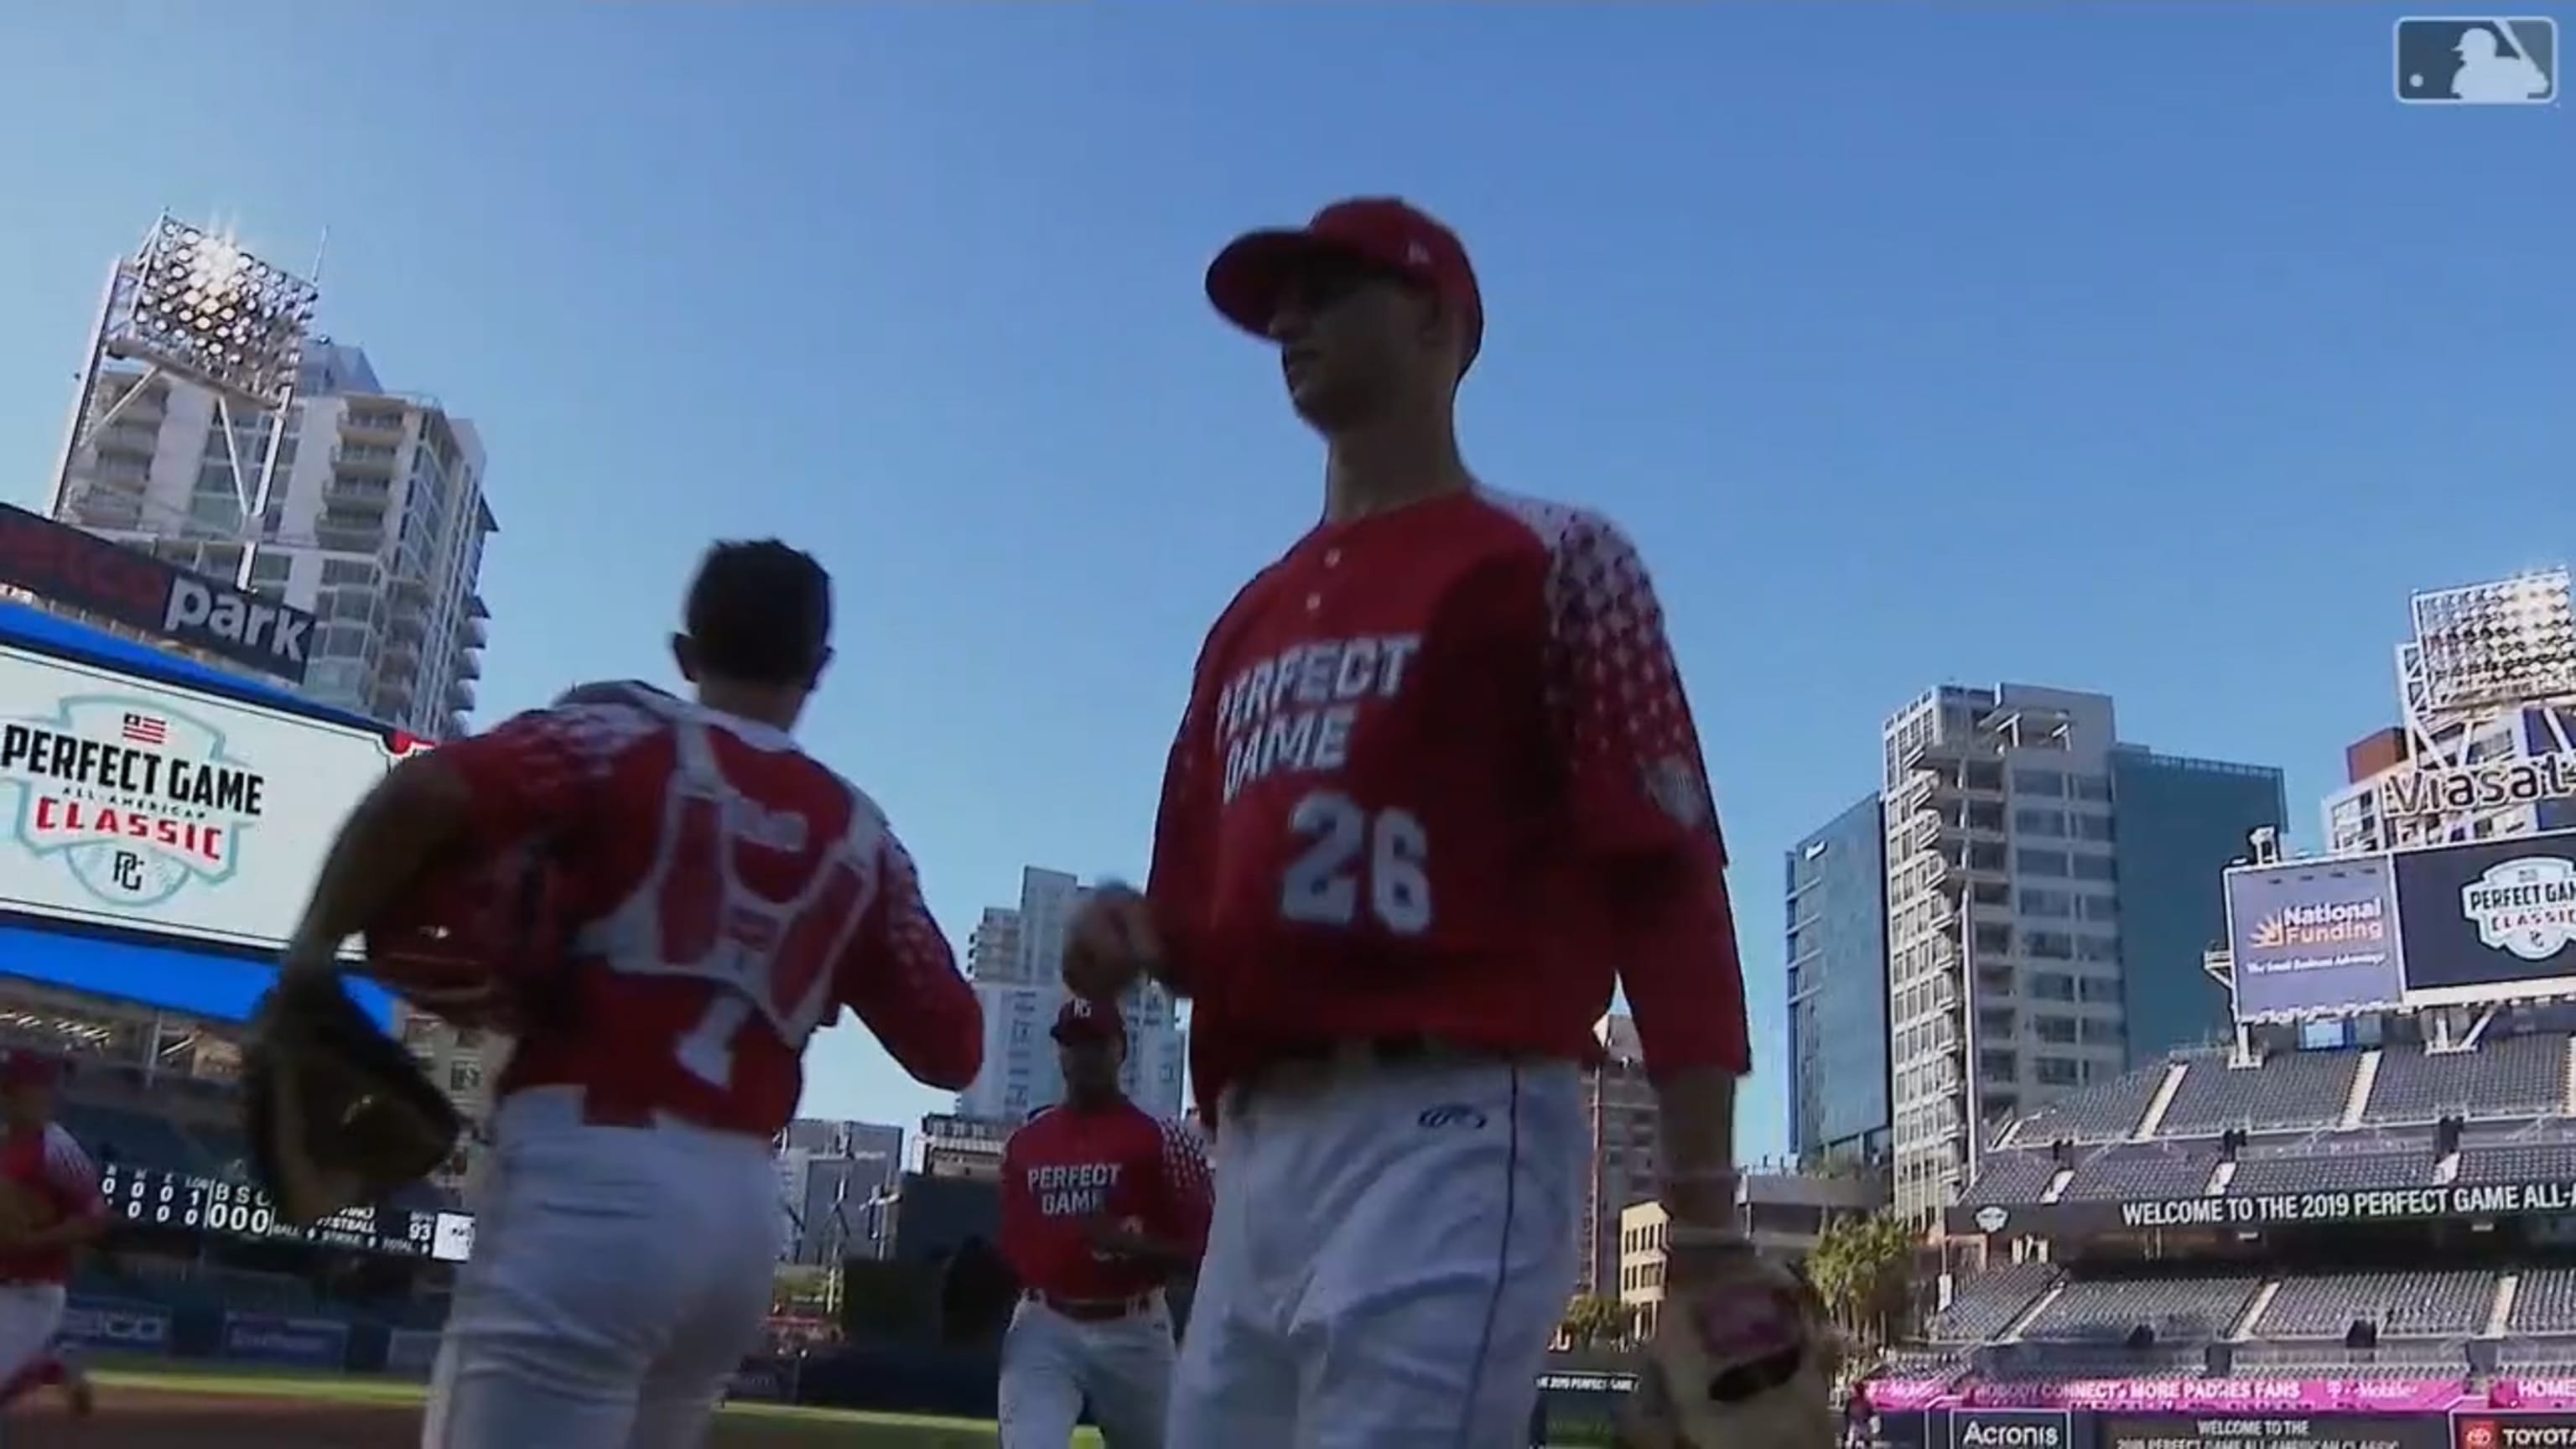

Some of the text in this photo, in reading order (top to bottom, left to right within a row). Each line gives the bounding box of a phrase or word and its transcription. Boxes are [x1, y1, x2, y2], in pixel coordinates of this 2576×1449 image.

[164, 575, 307, 662] park
[1215, 637, 1421, 749] PERFECT
[1223, 704, 1357, 805] GAME
[1, 724, 264, 815] PERFECT GAME
[2388, 754, 2569, 811] Viasat
[36, 797, 222, 860] CLASSIC
[1281, 792, 1430, 935] 26
[2283, 896, 2381, 926] National
[2470, 885, 2541, 911] PERFECT
[2285, 921, 2384, 946] Funding
[101, 1177, 200, 1206] 0 0 0 1
[1027, 1163, 1121, 1191] PERFECT
[2122, 1198, 2223, 1225] WELCOME
[2226, 1197, 2253, 1221] TO
[2257, 1194, 2298, 1219] THE
[2301, 1192, 2349, 1218] 2019
[2354, 1187, 2449, 1215] PERFECT
[2453, 1185, 2519, 1212] GAME
[408, 1223, 432, 1241] 93
[2131, 1382, 2179, 1399] MORE
[2183, 1383, 2251, 1399] PADRES
[2255, 1383, 2301, 1399] FANS
[2517, 1379, 2576, 1398] HOME
[1963, 1420, 2059, 1446] Acronis
[2197, 1420, 2309, 1436] WELCOME TO THE
